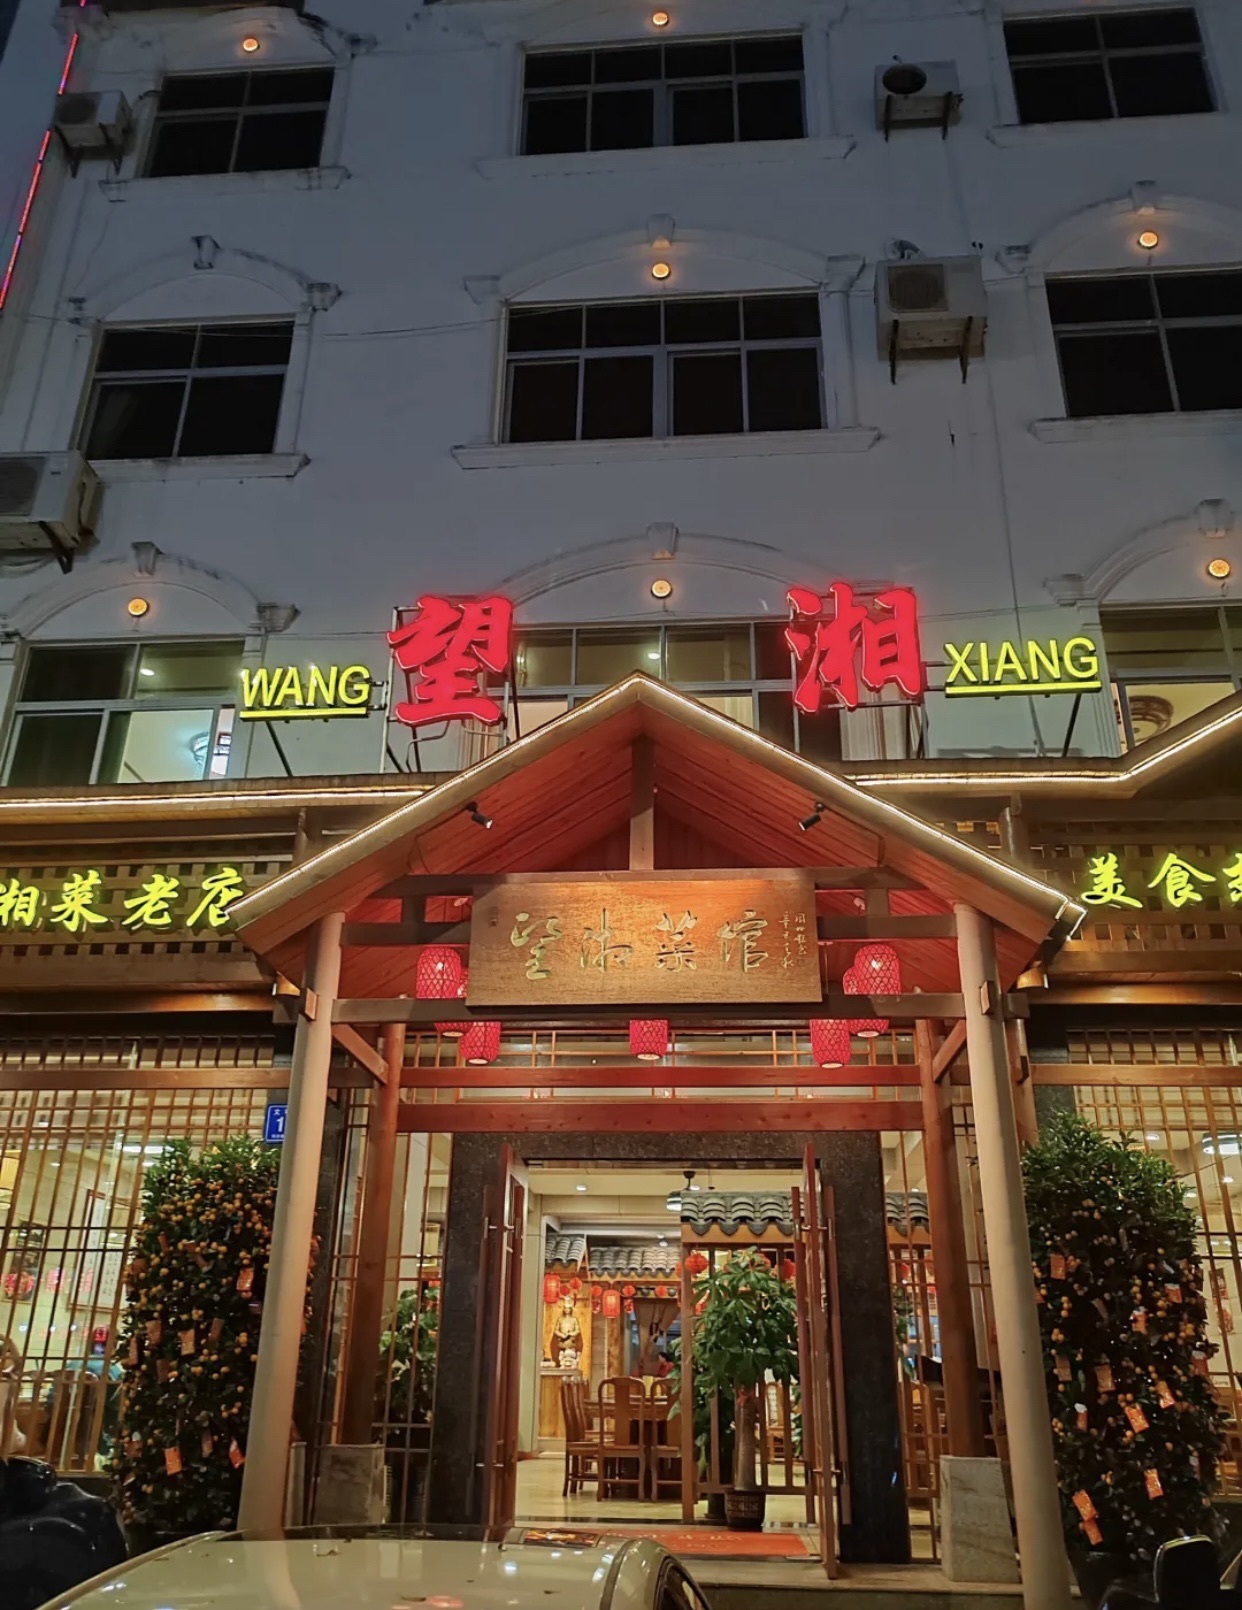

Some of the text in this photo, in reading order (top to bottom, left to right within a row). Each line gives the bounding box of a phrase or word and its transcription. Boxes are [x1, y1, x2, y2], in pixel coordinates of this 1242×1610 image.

[387, 582, 921, 726] 望 湘
[945, 637, 1099, 683] XIANG
[241, 666, 371, 707] WANG
